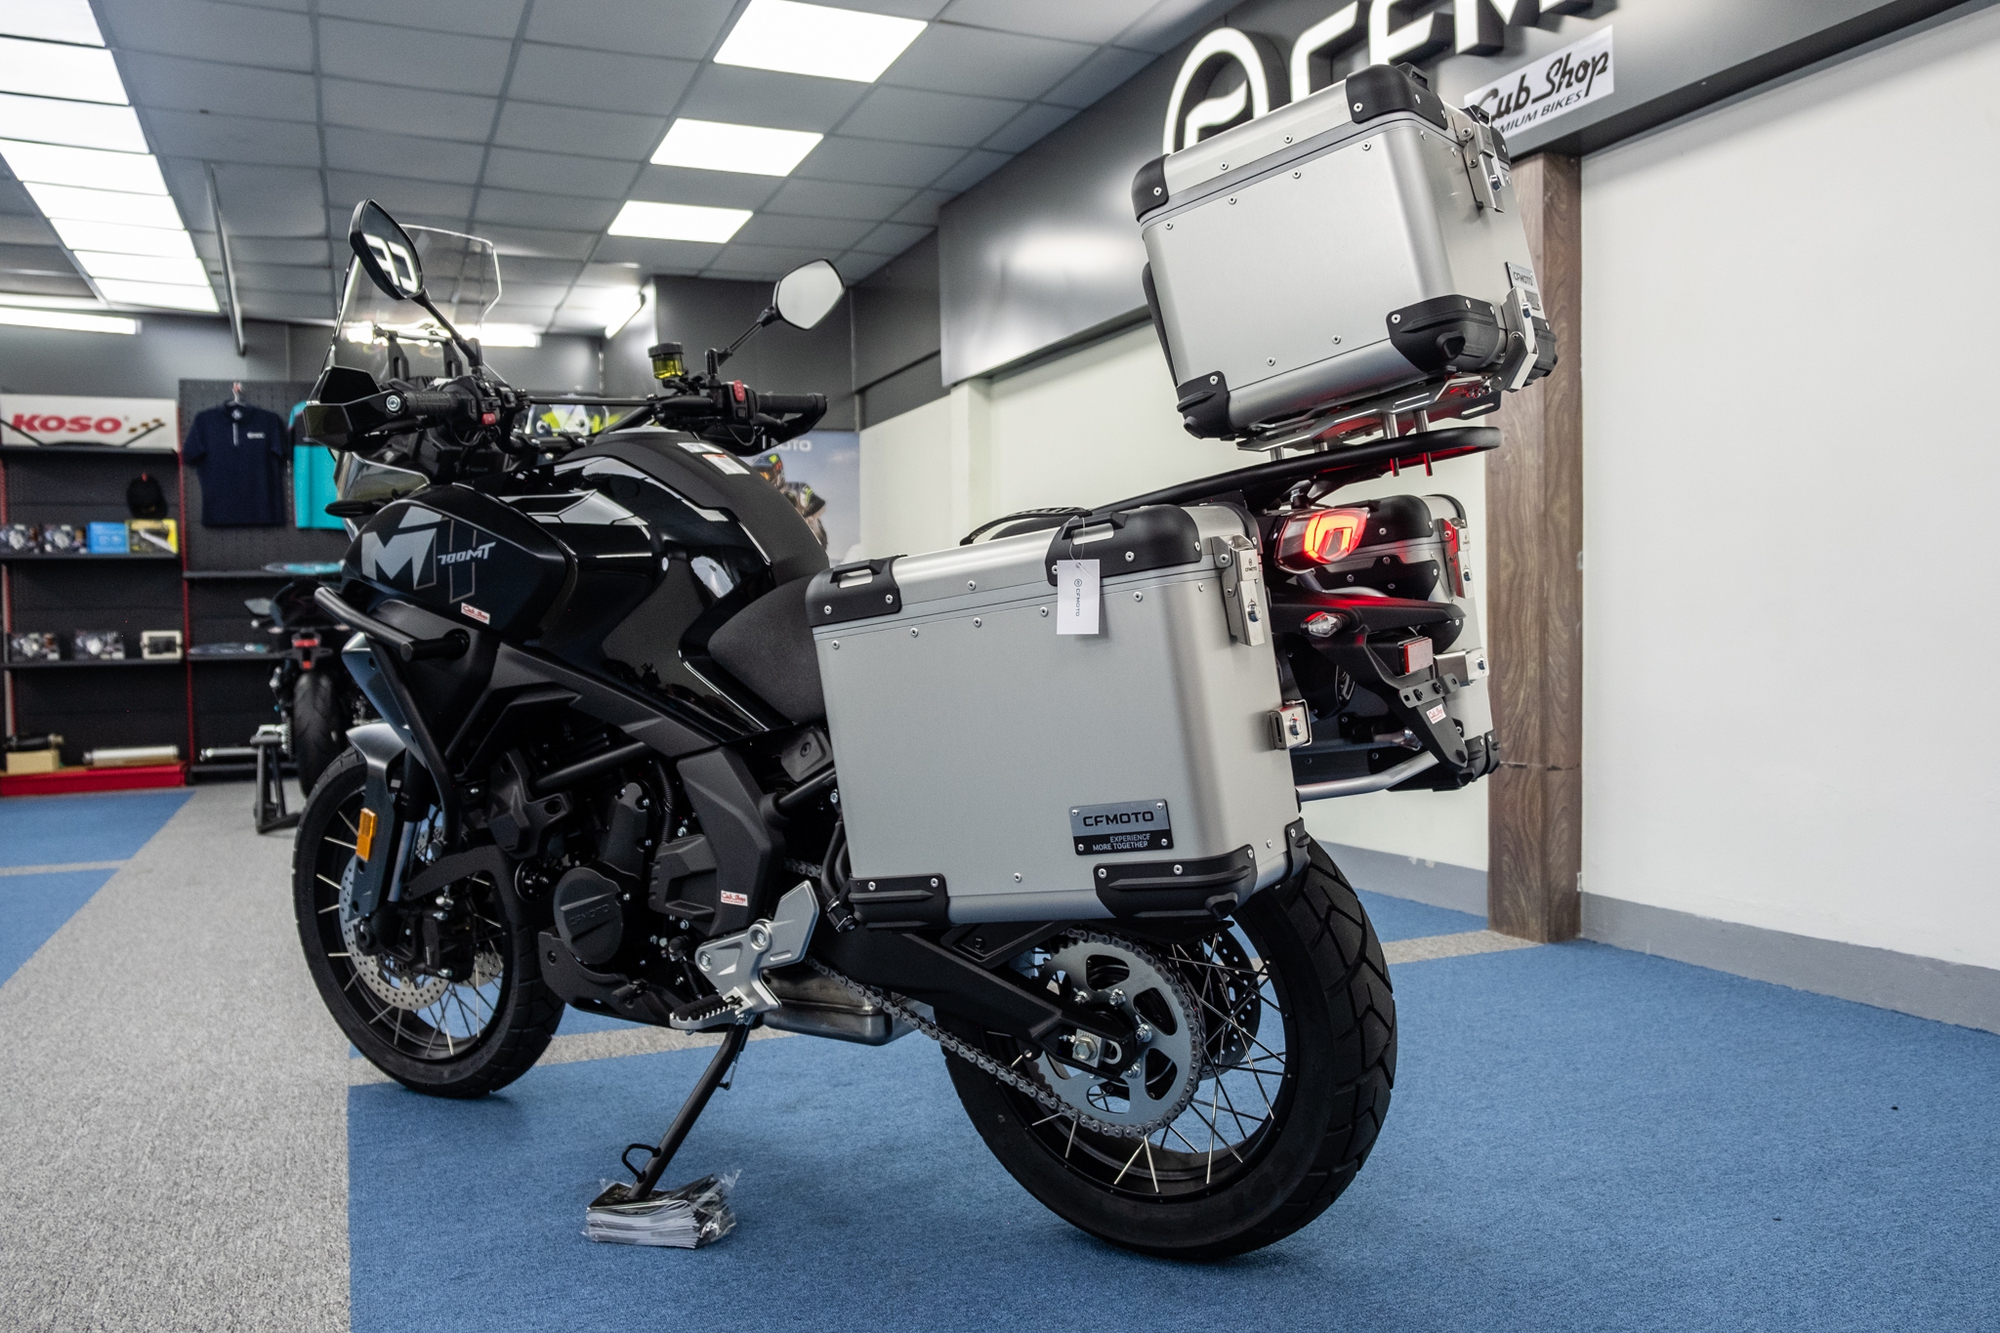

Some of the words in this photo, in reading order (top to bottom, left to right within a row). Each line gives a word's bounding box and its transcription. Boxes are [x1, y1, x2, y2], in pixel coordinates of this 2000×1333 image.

[1478, 73, 1531, 122] Cub
[1531, 51, 1609, 104] Shop
[1497, 109, 1538, 134] MIUM
[1540, 89, 1584, 117] BIKES
[10, 413, 122, 435] KOSO
[437, 541, 497, 565] 700MT
[1082, 810, 1155, 828] CFMOTO
[1092, 844, 1113, 852] MORE
[1113, 840, 1149, 850] TOGETHER
[1109, 833, 1151, 843] EXPERIENCE
